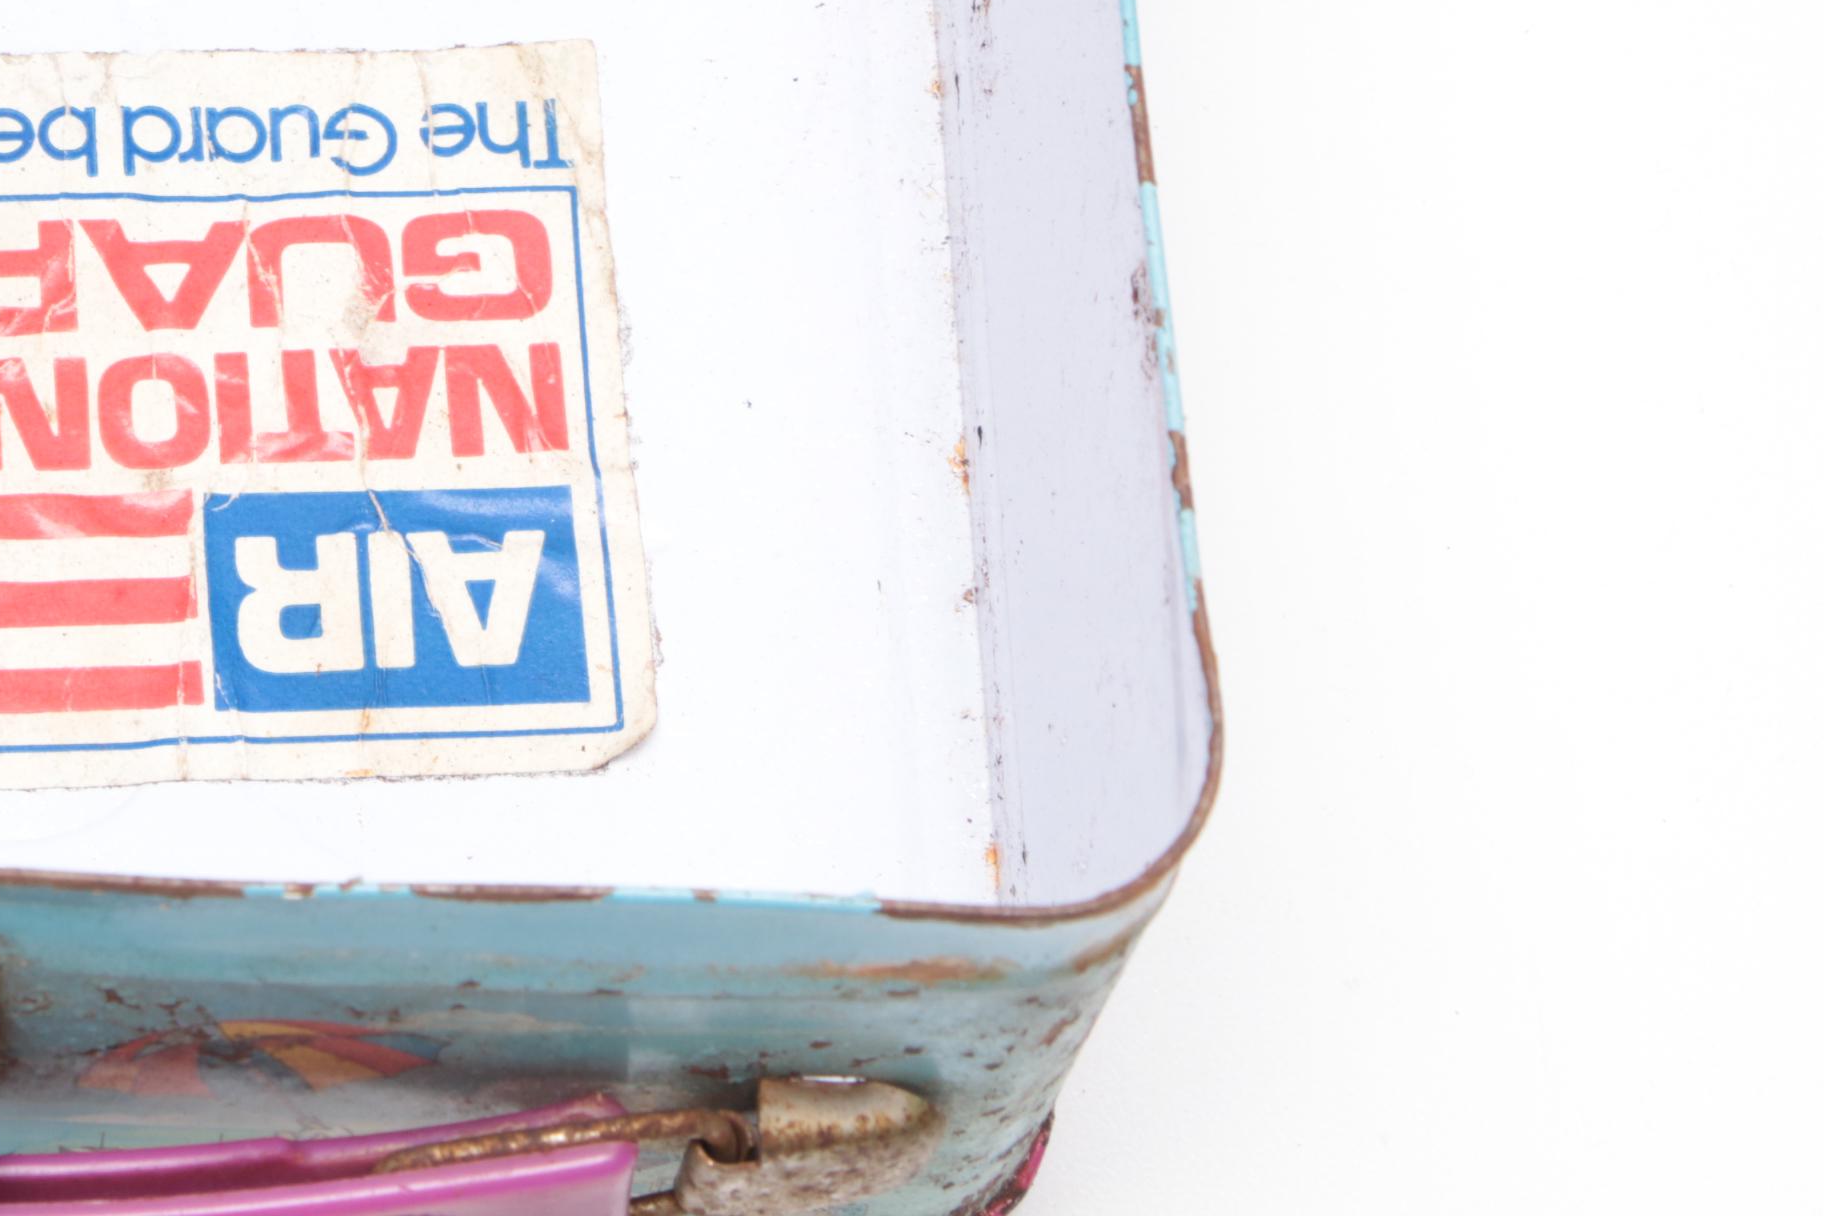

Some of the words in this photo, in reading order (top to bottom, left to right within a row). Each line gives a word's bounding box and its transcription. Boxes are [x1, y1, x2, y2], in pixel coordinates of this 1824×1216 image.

[122, 102, 398, 177] Guard
[420, 98, 574, 170] The
[234, 529, 546, 674] AIR
